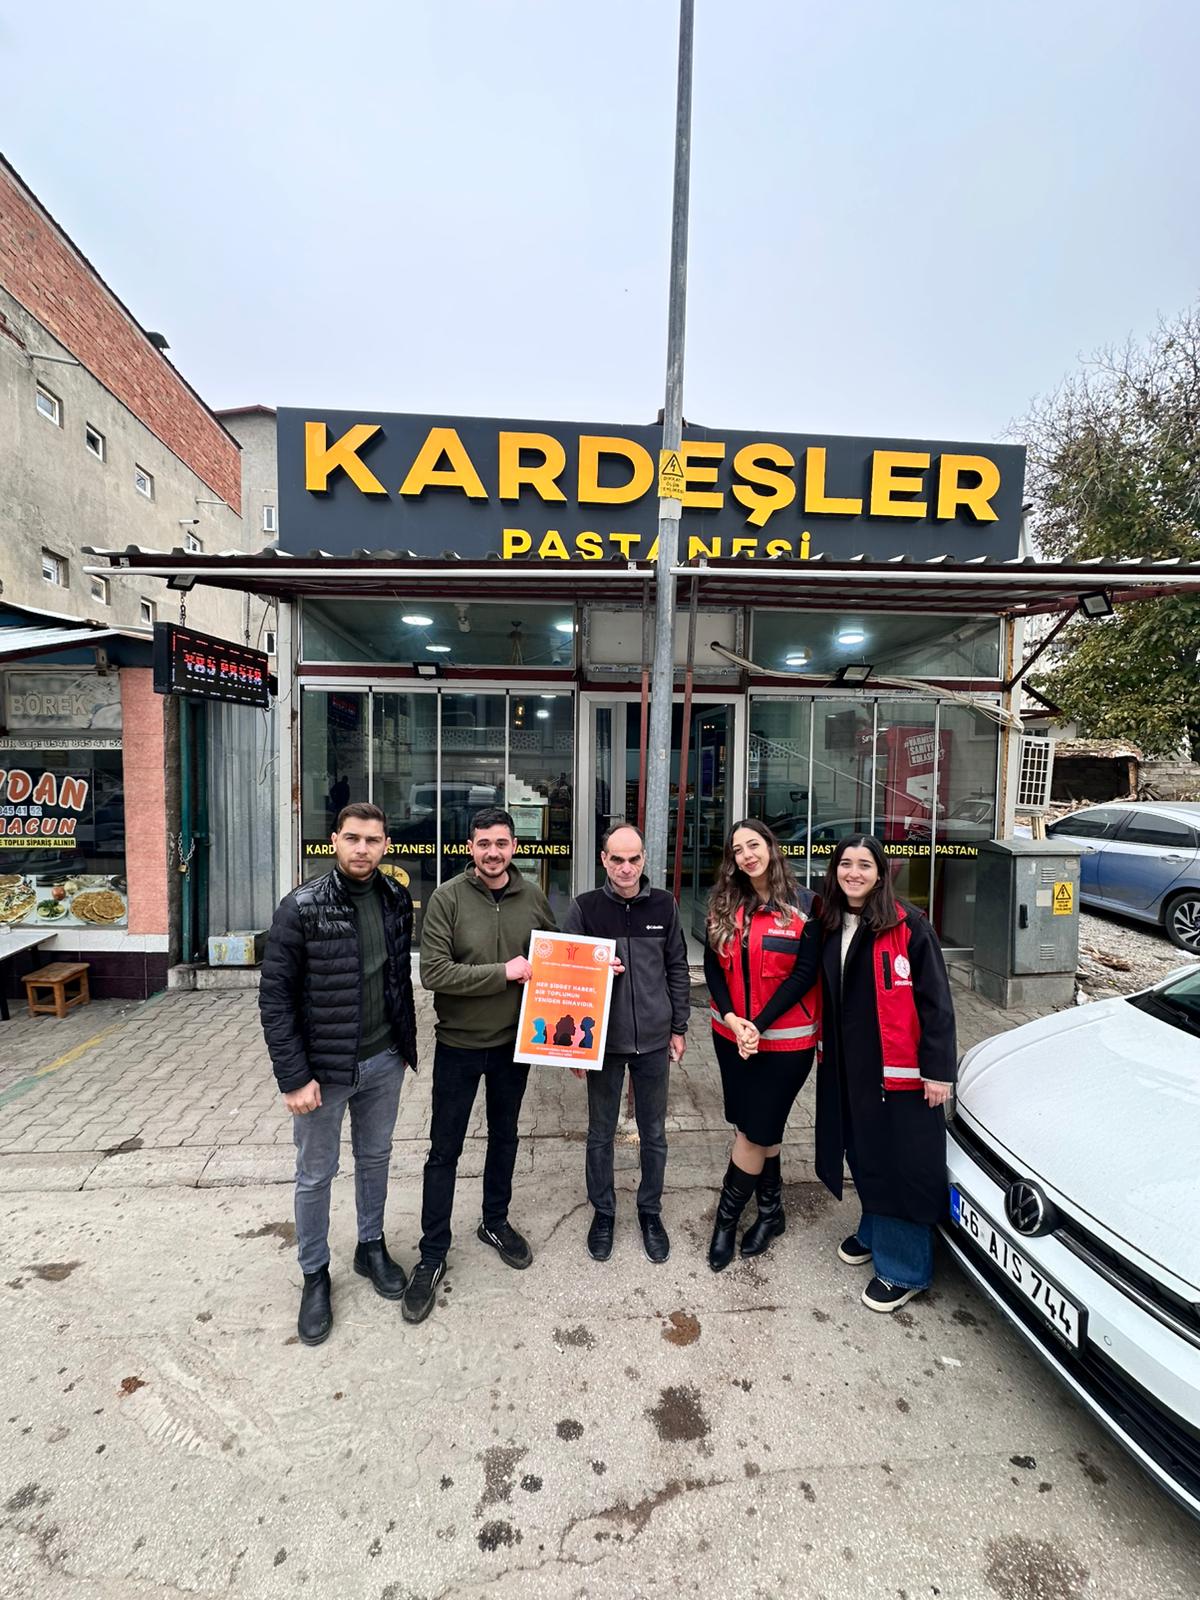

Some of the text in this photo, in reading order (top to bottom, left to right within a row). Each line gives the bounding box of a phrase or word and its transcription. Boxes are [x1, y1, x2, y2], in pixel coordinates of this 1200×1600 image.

[305, 421, 1000, 527] KARDEŞLER
[11, 691, 88, 716] BÖREK
[109, 740, 123, 748] 52
[16, 806, 28, 816] 41
[26, 838, 52, 847] SİPARİŞ
[387, 844, 436, 854] STANESİ
[935, 845, 979, 856] PASTAN
[961, 1201, 979, 1238] 46
[989, 1231, 1022, 1284] AIS
[1031, 1270, 1072, 1336] 744
